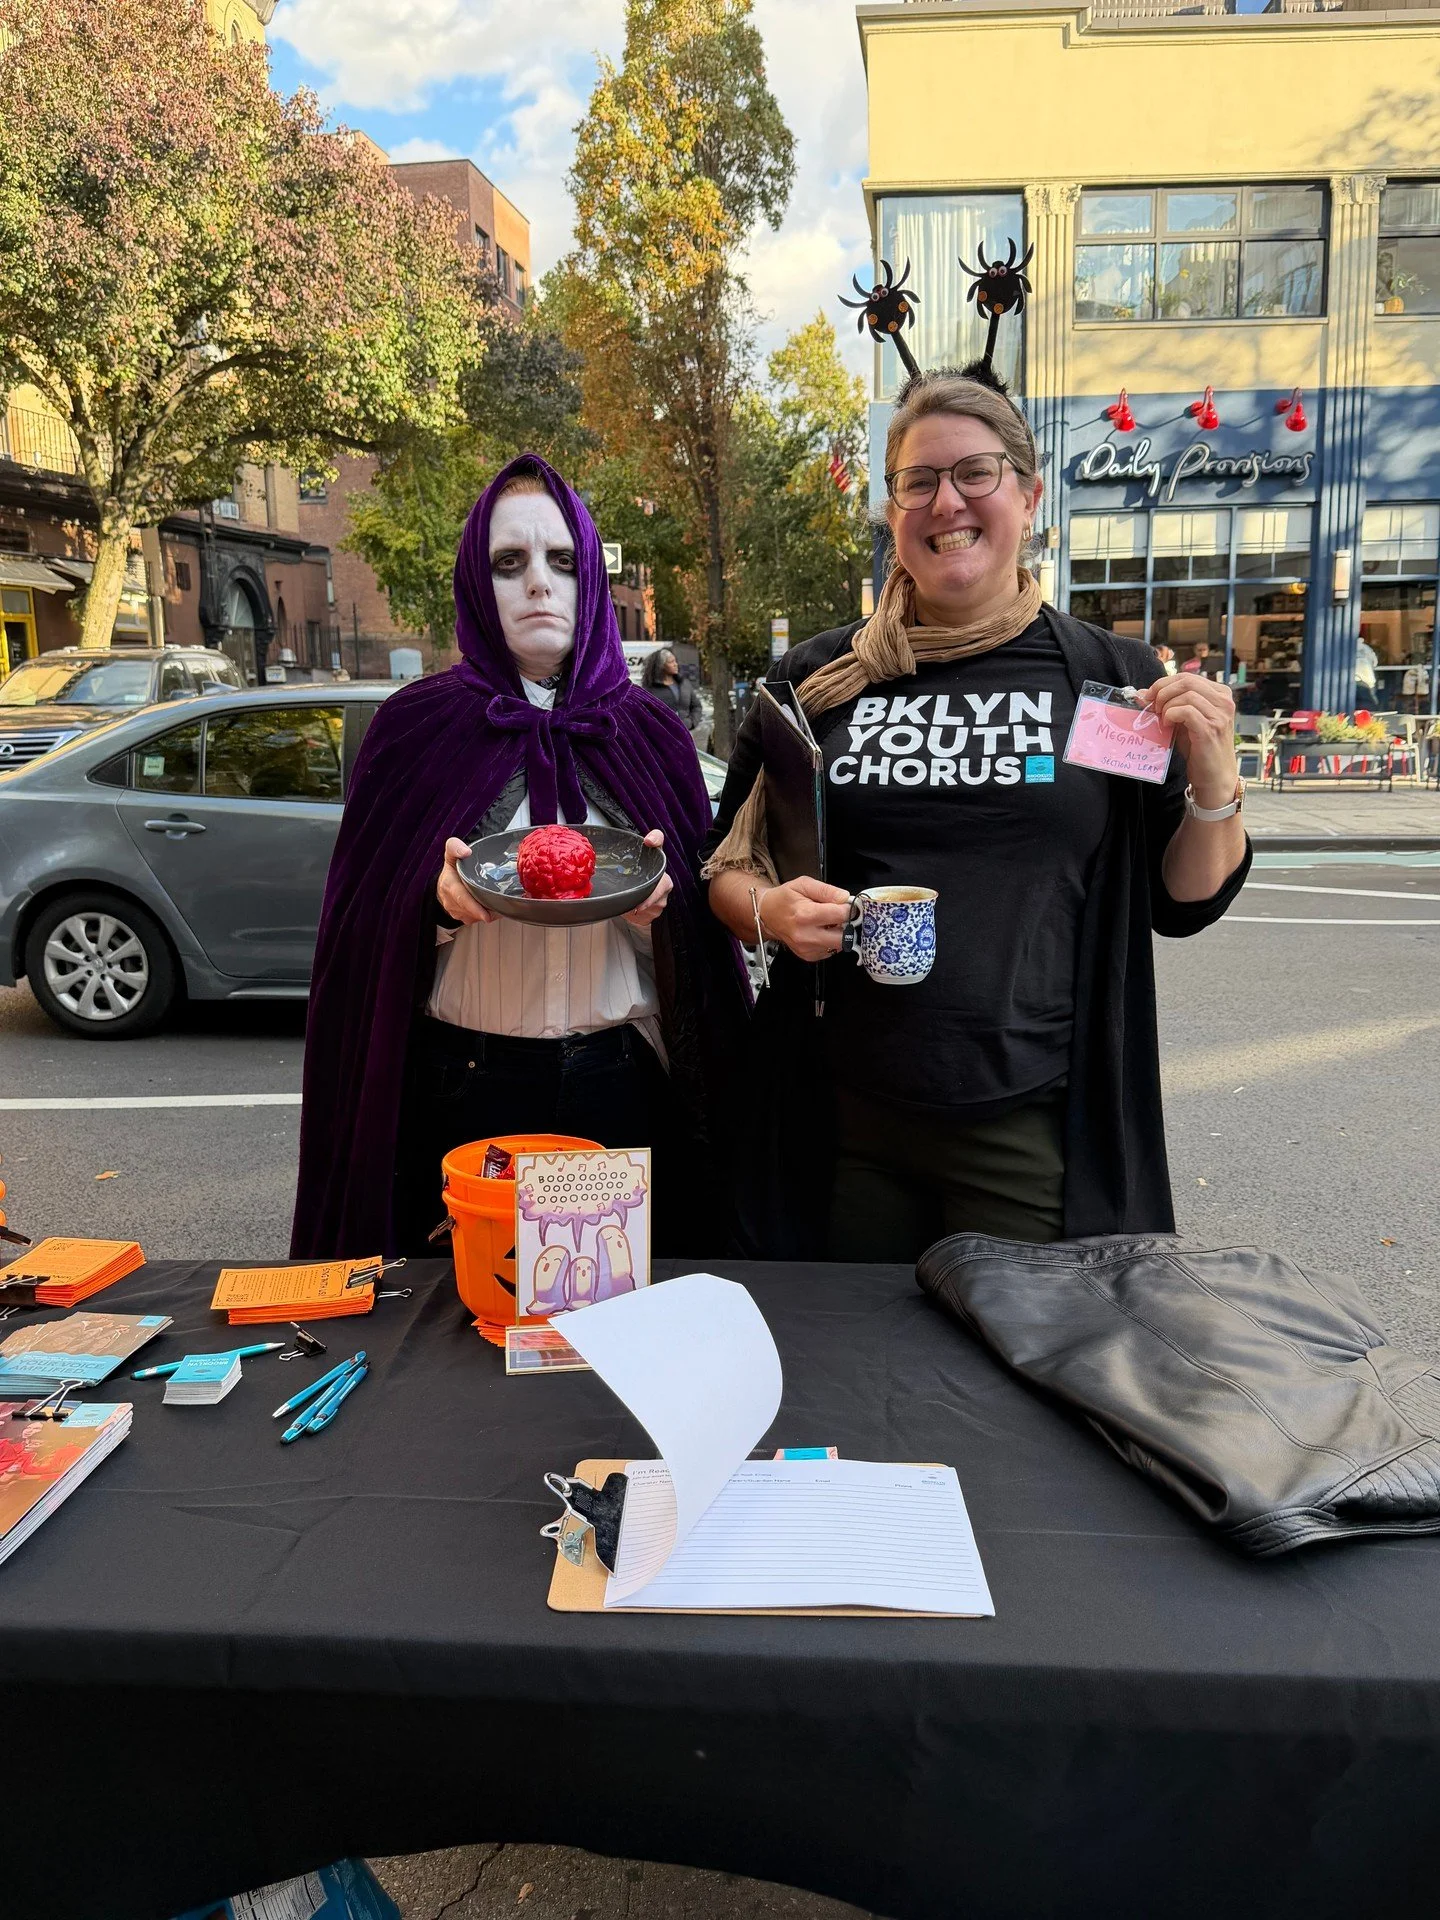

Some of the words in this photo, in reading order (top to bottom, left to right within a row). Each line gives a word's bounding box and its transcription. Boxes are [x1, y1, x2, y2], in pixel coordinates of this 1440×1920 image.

[1081, 438, 1161, 497] Daily
[1166, 441, 1315, 503] Provisions
[850, 691, 1053, 726] BKLYN
[847, 725, 1055, 758] YOUTH
[1095, 723, 1146, 746] MEGAN
[1100, 756, 1131, 770] SECTION
[1125, 751, 1149, 761] ALTO
[829, 755, 1022, 786] CHORUS
[10, 1365, 87, 1375] AMPLIFIED.
[18, 1359, 58, 1367] YOUR
